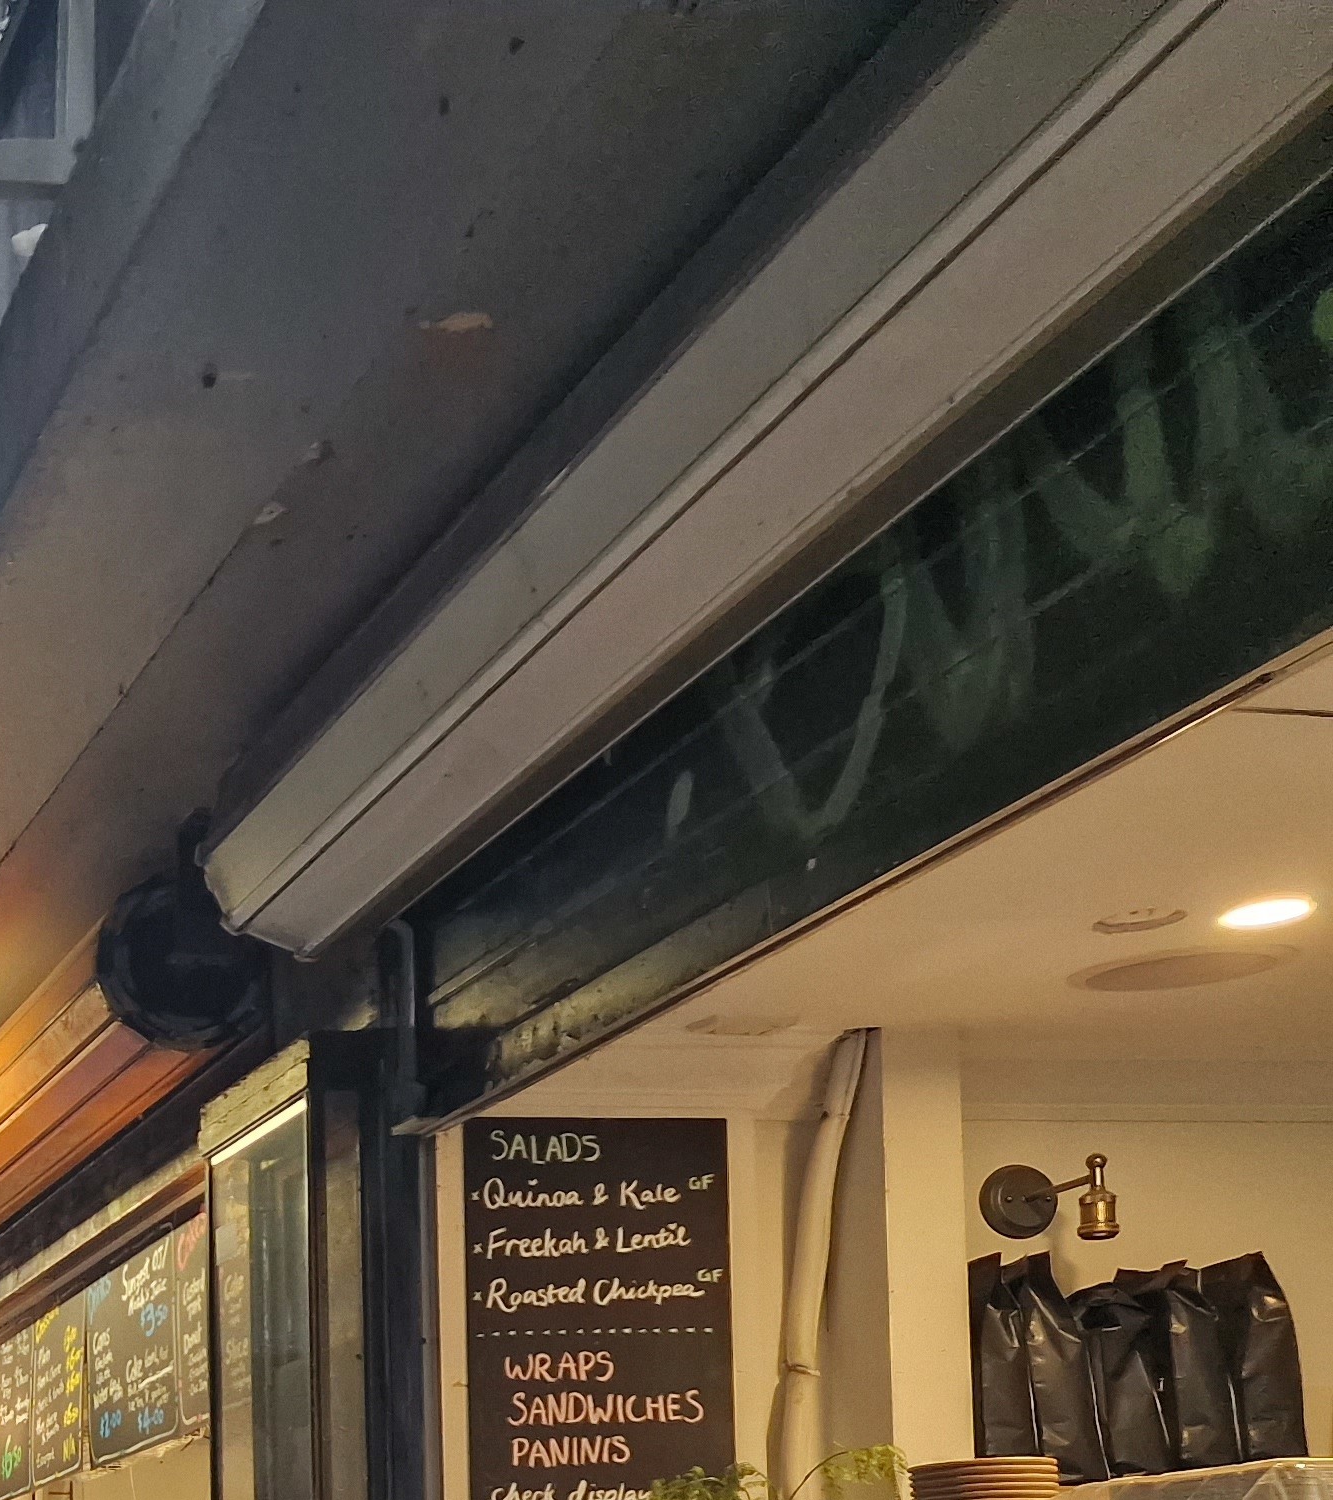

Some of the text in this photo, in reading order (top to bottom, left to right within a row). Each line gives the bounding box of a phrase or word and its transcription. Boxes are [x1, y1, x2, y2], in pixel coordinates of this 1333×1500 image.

[489, 1129, 601, 1164] SALADS
[482, 1177, 584, 1210] Quinoa
[619, 1178, 682, 1210] Kale
[616, 1222, 691, 1254] Lentil
[485, 1277, 586, 1313] Roasted
[593, 1277, 706, 1306] Chickpea
[504, 1350, 614, 1382] WRAPS
[508, 1389, 705, 1428] SANDWICHES
[511, 1434, 631, 1468] PANINIS
